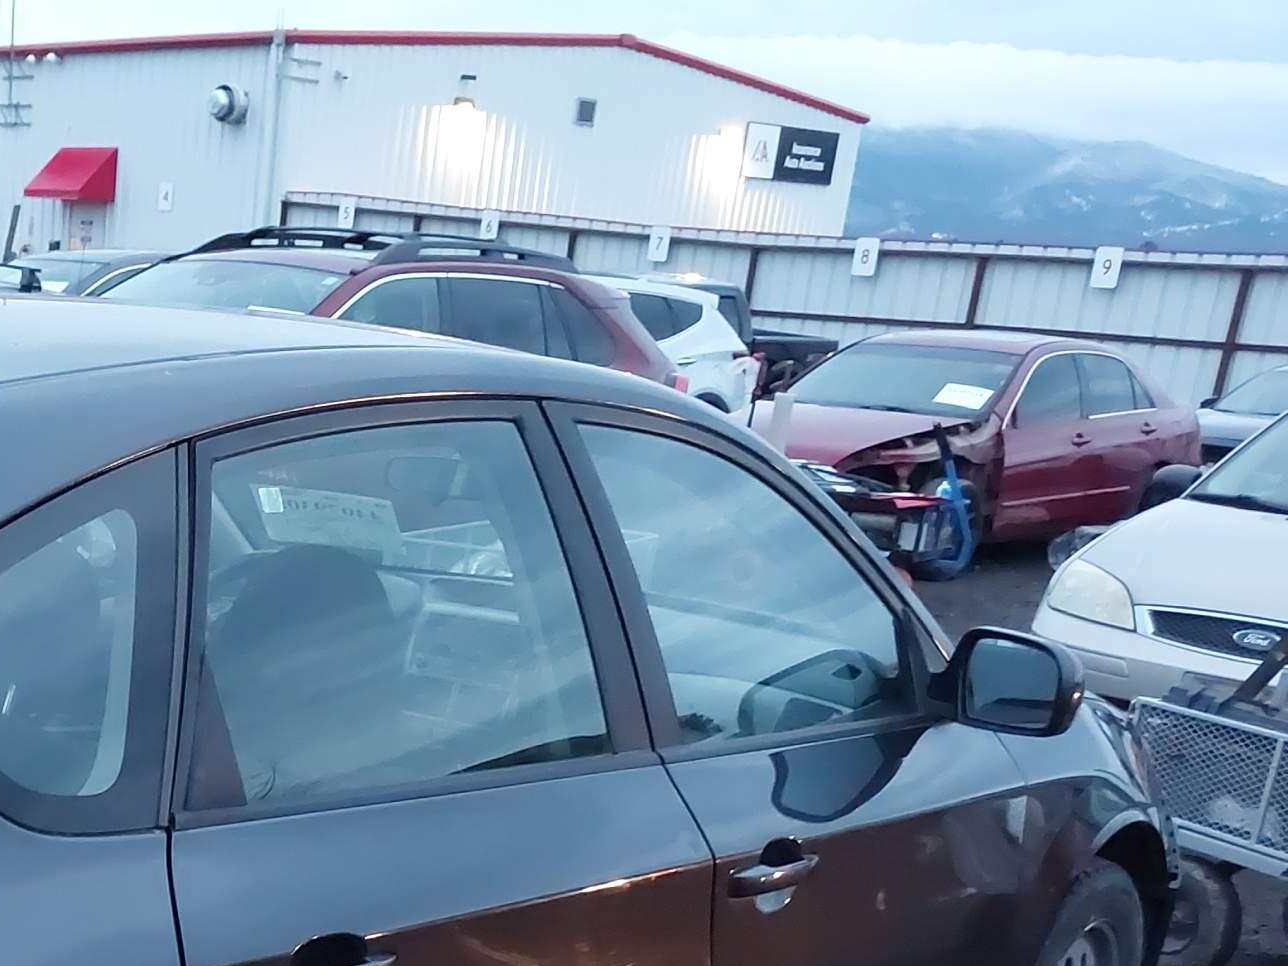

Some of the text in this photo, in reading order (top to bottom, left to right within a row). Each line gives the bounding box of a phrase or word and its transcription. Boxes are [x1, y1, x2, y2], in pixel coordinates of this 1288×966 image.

[655, 236, 663, 251] 7
[861, 248, 870, 265] 8
[1103, 258, 1112, 276] 9
